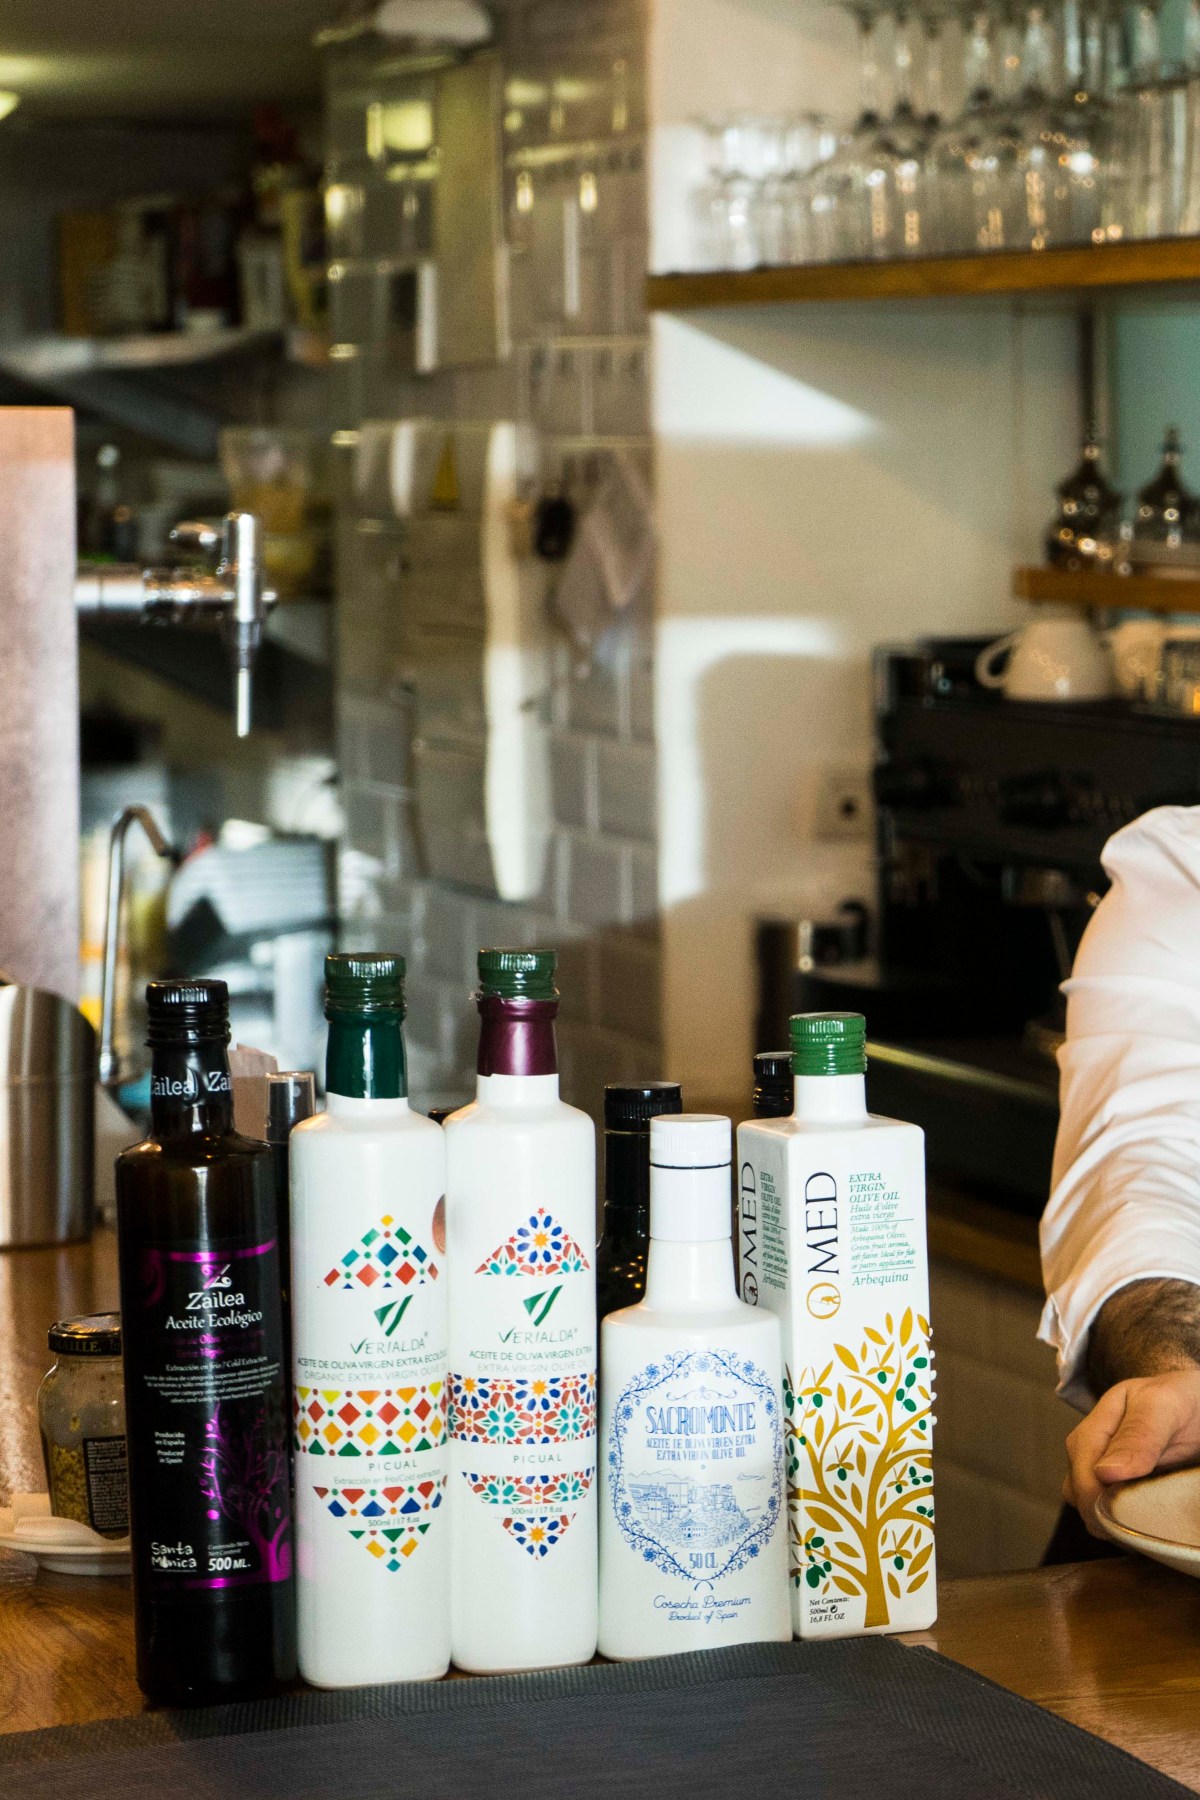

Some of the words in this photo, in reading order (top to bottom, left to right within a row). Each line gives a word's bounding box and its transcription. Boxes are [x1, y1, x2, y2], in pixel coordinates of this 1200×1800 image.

[849, 1172, 882, 1183] EXTRA
[850, 1182, 887, 1193] VIRGIN
[850, 1192, 880, 1204] OLIVE
[882, 1191, 900, 1201] OIL
[850, 1203, 871, 1214] Huile
[850, 1213, 870, 1221] extra
[852, 1271, 909, 1286] Arbequina
[185, 1291, 245, 1310] Zailea
[165, 1315, 206, 1330] Aceite
[207, 1309, 263, 1329] Ecológico
[469, 1350, 498, 1360] ACEITE
[500, 1352, 513, 1361] DE
[515, 1352, 545, 1361] OLIVA
[545, 1349, 575, 1360] VIRGEN
[226, 1359, 241, 1368] Cold
[297, 1357, 318, 1368] ACEITE
[318, 1360, 330, 1369] DE
[331, 1360, 357, 1370] OLIVA
[358, 1359, 394, 1369] VIRGEN
[397, 1356, 424, 1367] EXTRA
[477, 1362, 512, 1373] EXTRA
[513, 1363, 548, 1373] VIRGIN
[551, 1361, 576, 1372] OLIVE
[303, 1370, 345, 1382] ORGANIC
[348, 1371, 384, 1382] EXTRA
[386, 1368, 418, 1380] VIRGIN
[420, 1364, 440, 1376] OLIVE
[645, 1401, 756, 1437] SACROMONTE
[646, 1437, 671, 1449] ACEITE
[672, 1438, 682, 1449] DE
[684, 1438, 706, 1449] OLIVA
[706, 1436, 734, 1449] VIRGEN
[735, 1434, 756, 1446] EXTRA
[513, 1454, 562, 1464] PICUAL
[656, 1449, 681, 1461] EXTRA
[711, 1447, 733, 1460] OLIVE
[735, 1446, 746, 1458] OIL
[368, 1460, 418, 1472] PICUAL
[511, 1507, 534, 1515] 500ml
[540, 1506, 547, 1514] 17
[368, 1518, 391, 1527] 500ml
[397, 1517, 405, 1525] 17
[151, 1541, 194, 1556] Santa
[207, 1556, 232, 1572] 500
[689, 1552, 703, 1569] 50
[704, 1552, 719, 1569] CL
[653, 1595, 699, 1609] Cosecha
[702, 1594, 753, 1609] Premium
[809, 1599, 820, 1607] Net
[668, 1610, 702, 1621] Product
[703, 1610, 714, 1625] of
[716, 1609, 739, 1623] Spain
[809, 1606, 829, 1616] 500ml
[823, 1614, 833, 1622] FL
[833, 1612, 846, 1621] OZ
